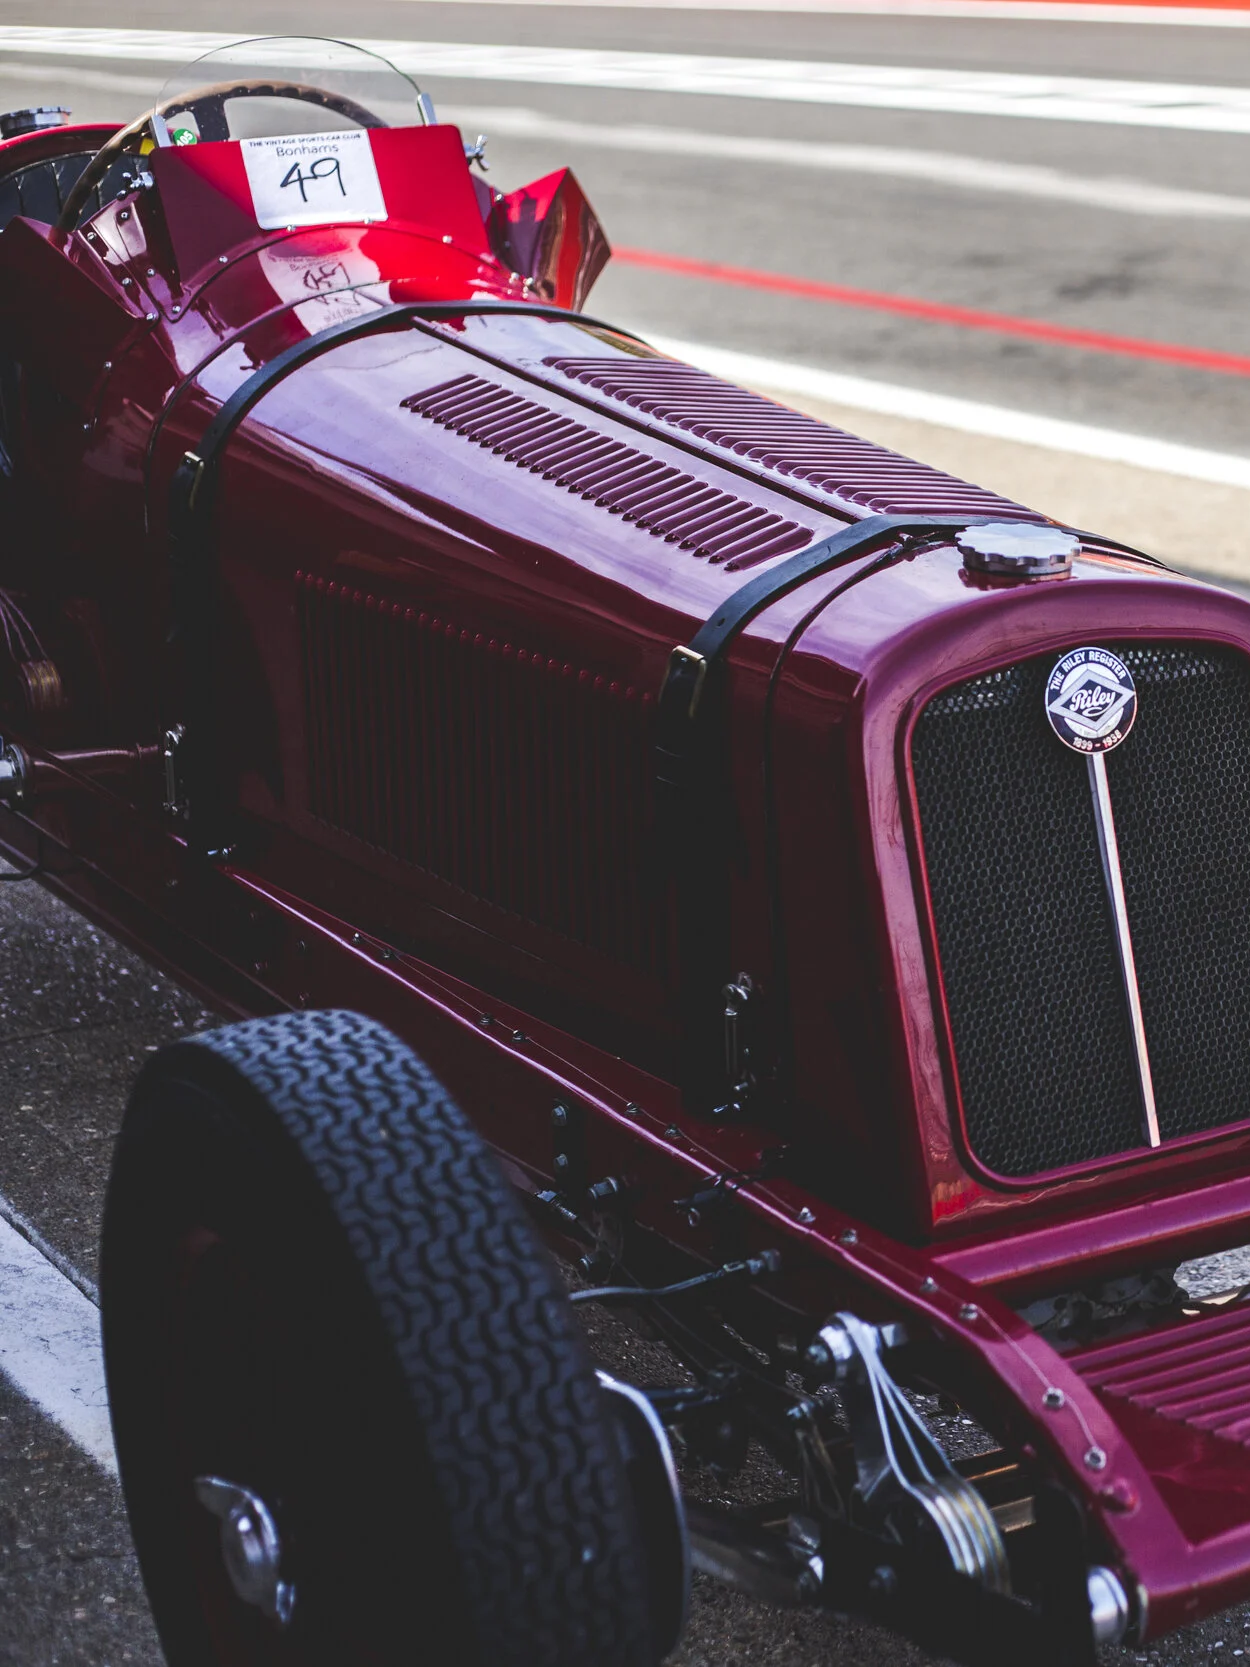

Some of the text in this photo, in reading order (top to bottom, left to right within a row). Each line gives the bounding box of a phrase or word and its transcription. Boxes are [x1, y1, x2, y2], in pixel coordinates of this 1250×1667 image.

[276, 144, 339, 157] Bonhams
[280, 157, 346, 202] 49
[1050, 651, 1127, 690] THE RILEY REGISTER
[1069, 685, 1116, 717] Riley
[1102, 729, 1122, 748] 1938
